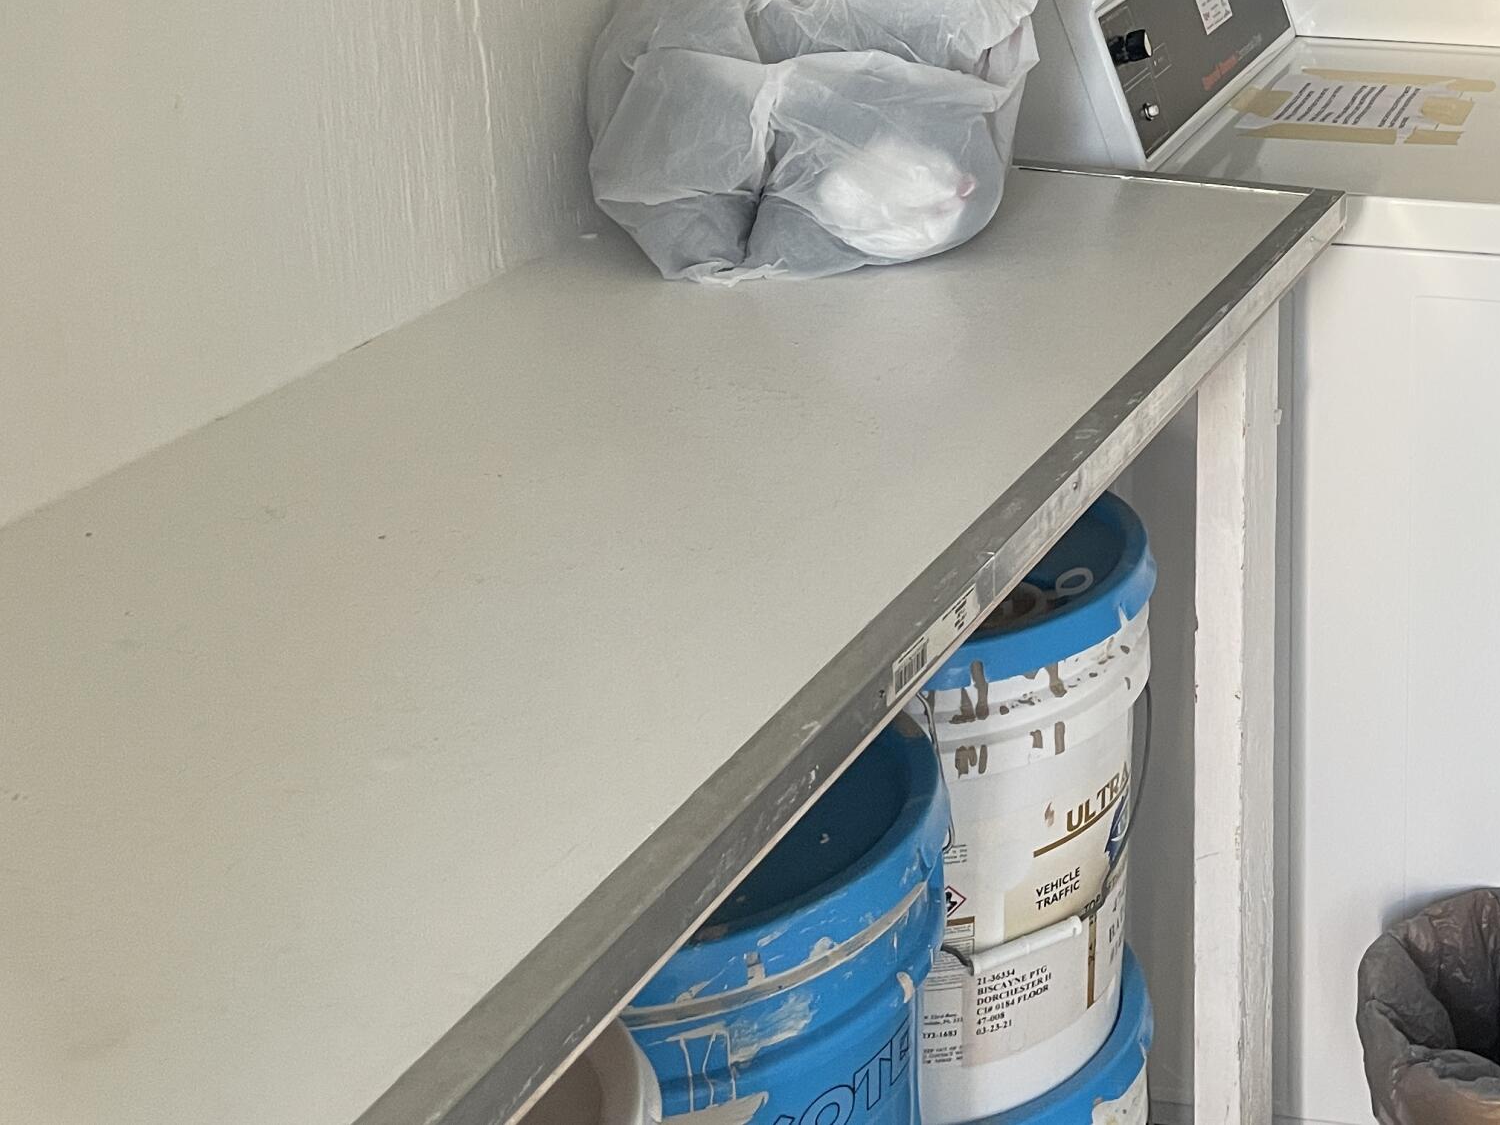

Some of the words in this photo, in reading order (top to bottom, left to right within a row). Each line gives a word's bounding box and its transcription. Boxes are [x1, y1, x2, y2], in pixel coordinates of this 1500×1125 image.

[1066, 761, 1131, 832] ULTRA
[1036, 866, 1081, 897] VEHICLE
[1036, 880, 1081, 911] TRAFFIC
[976, 977, 1044, 1006] DORCHESTER
[977, 974, 1027, 996] BISCAYNE
[1029, 965, 1048, 983] PTG
[1017, 984, 1050, 1004] FLOOR
[976, 1019, 1012, 1036] 03-23-21
